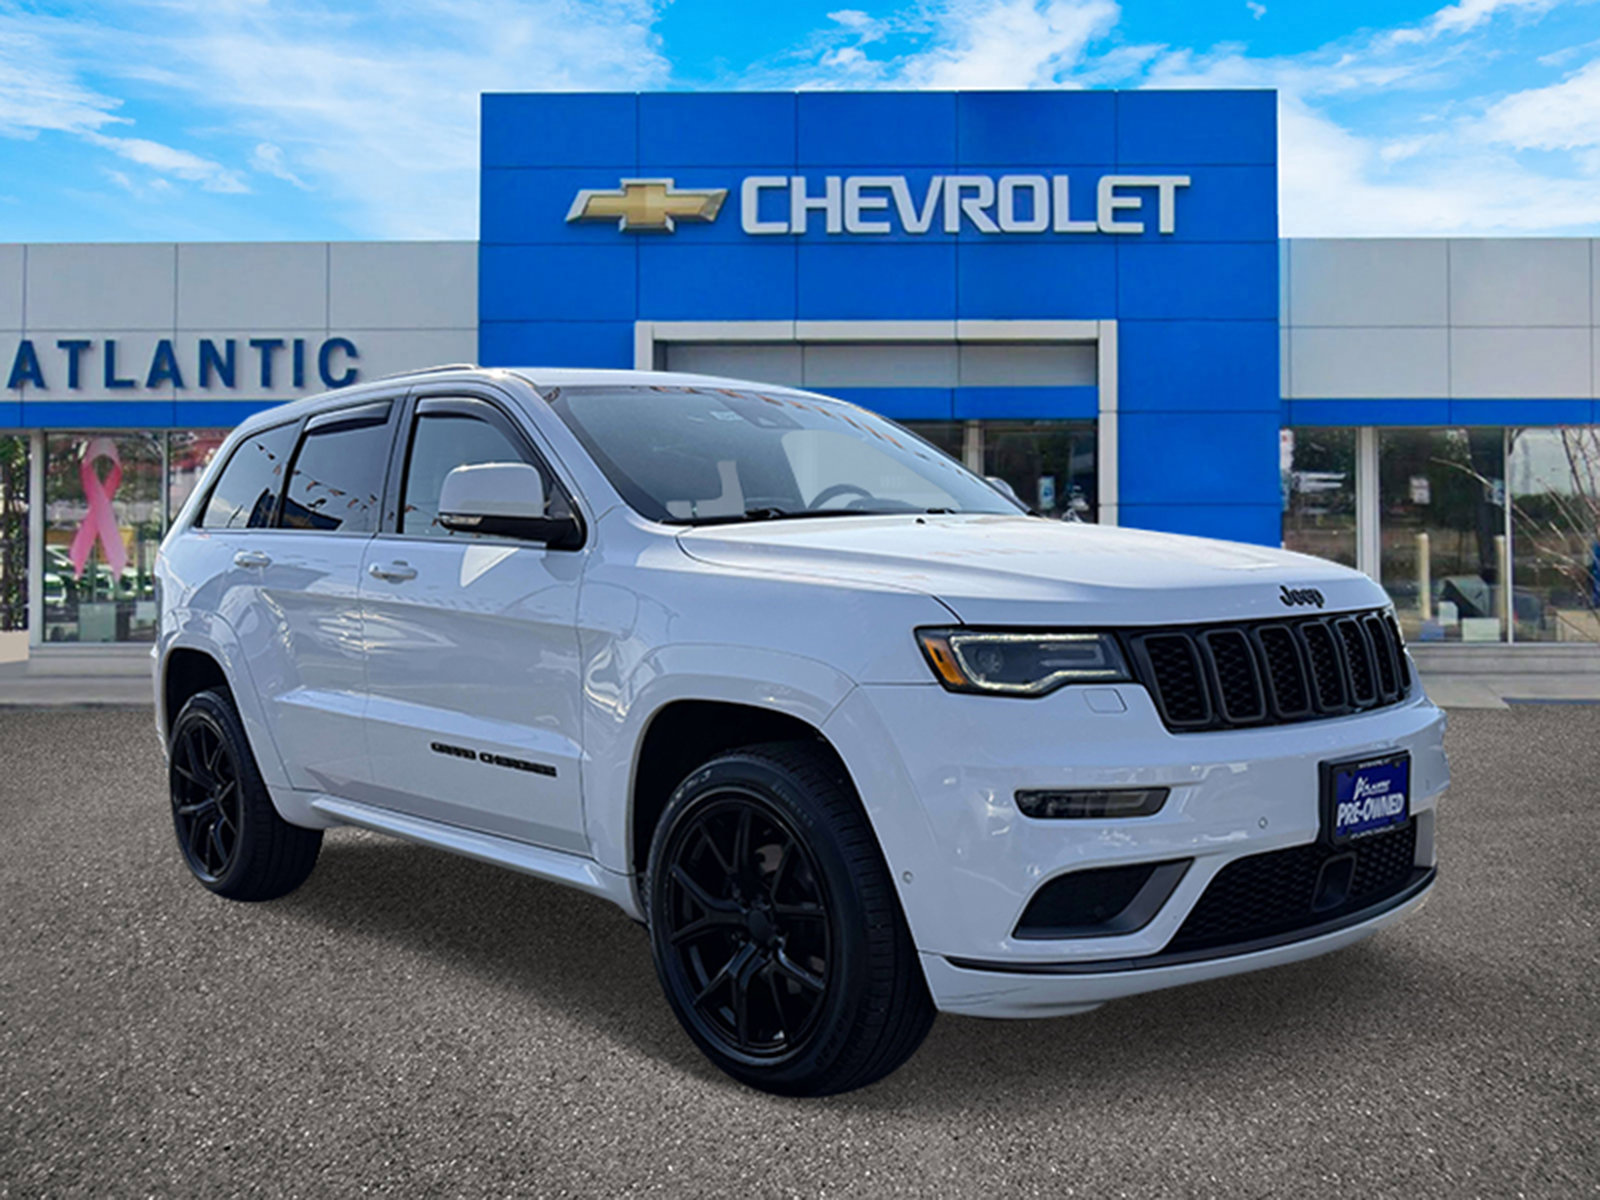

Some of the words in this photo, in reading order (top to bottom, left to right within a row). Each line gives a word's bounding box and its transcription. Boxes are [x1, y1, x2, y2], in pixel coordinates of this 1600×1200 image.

[741, 174, 1191, 234] CHEVROLET
[7, 338, 360, 390] ATLANTIC
[1280, 585, 1325, 608] Jeep
[1336, 793, 1405, 827] PRE-OWNED
